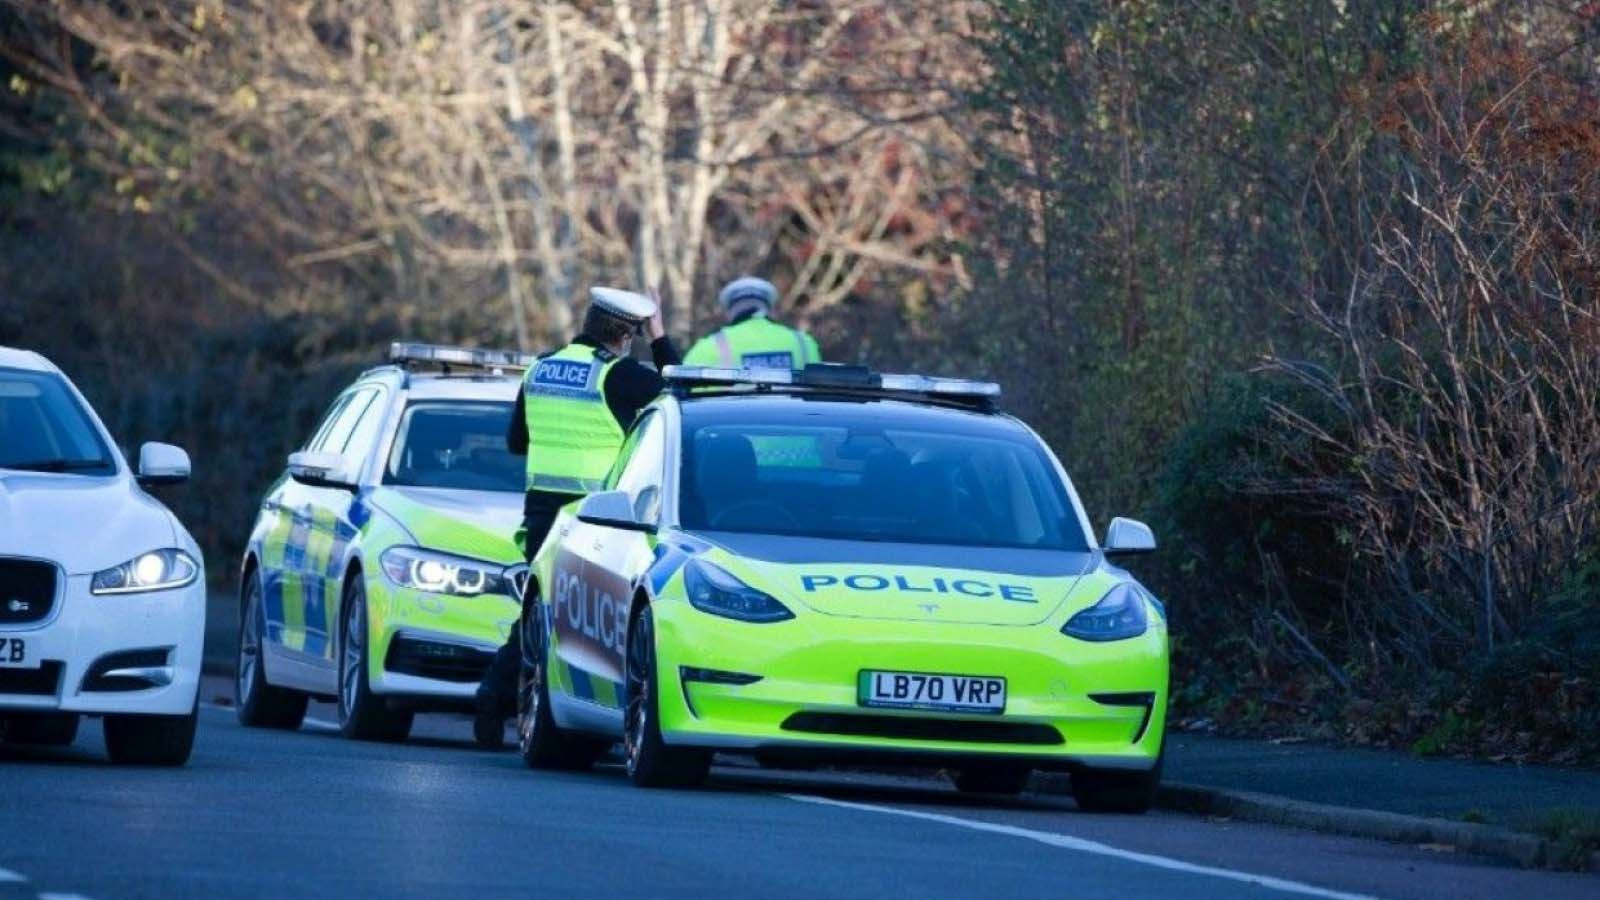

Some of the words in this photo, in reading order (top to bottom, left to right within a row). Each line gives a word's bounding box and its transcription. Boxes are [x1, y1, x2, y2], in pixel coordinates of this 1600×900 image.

[538, 364, 588, 384] POLICE
[800, 574, 1039, 604] POLICE
[555, 568, 628, 656] POLICE
[875, 674, 944, 701] LB70
[953, 678, 1002, 704] VRP
